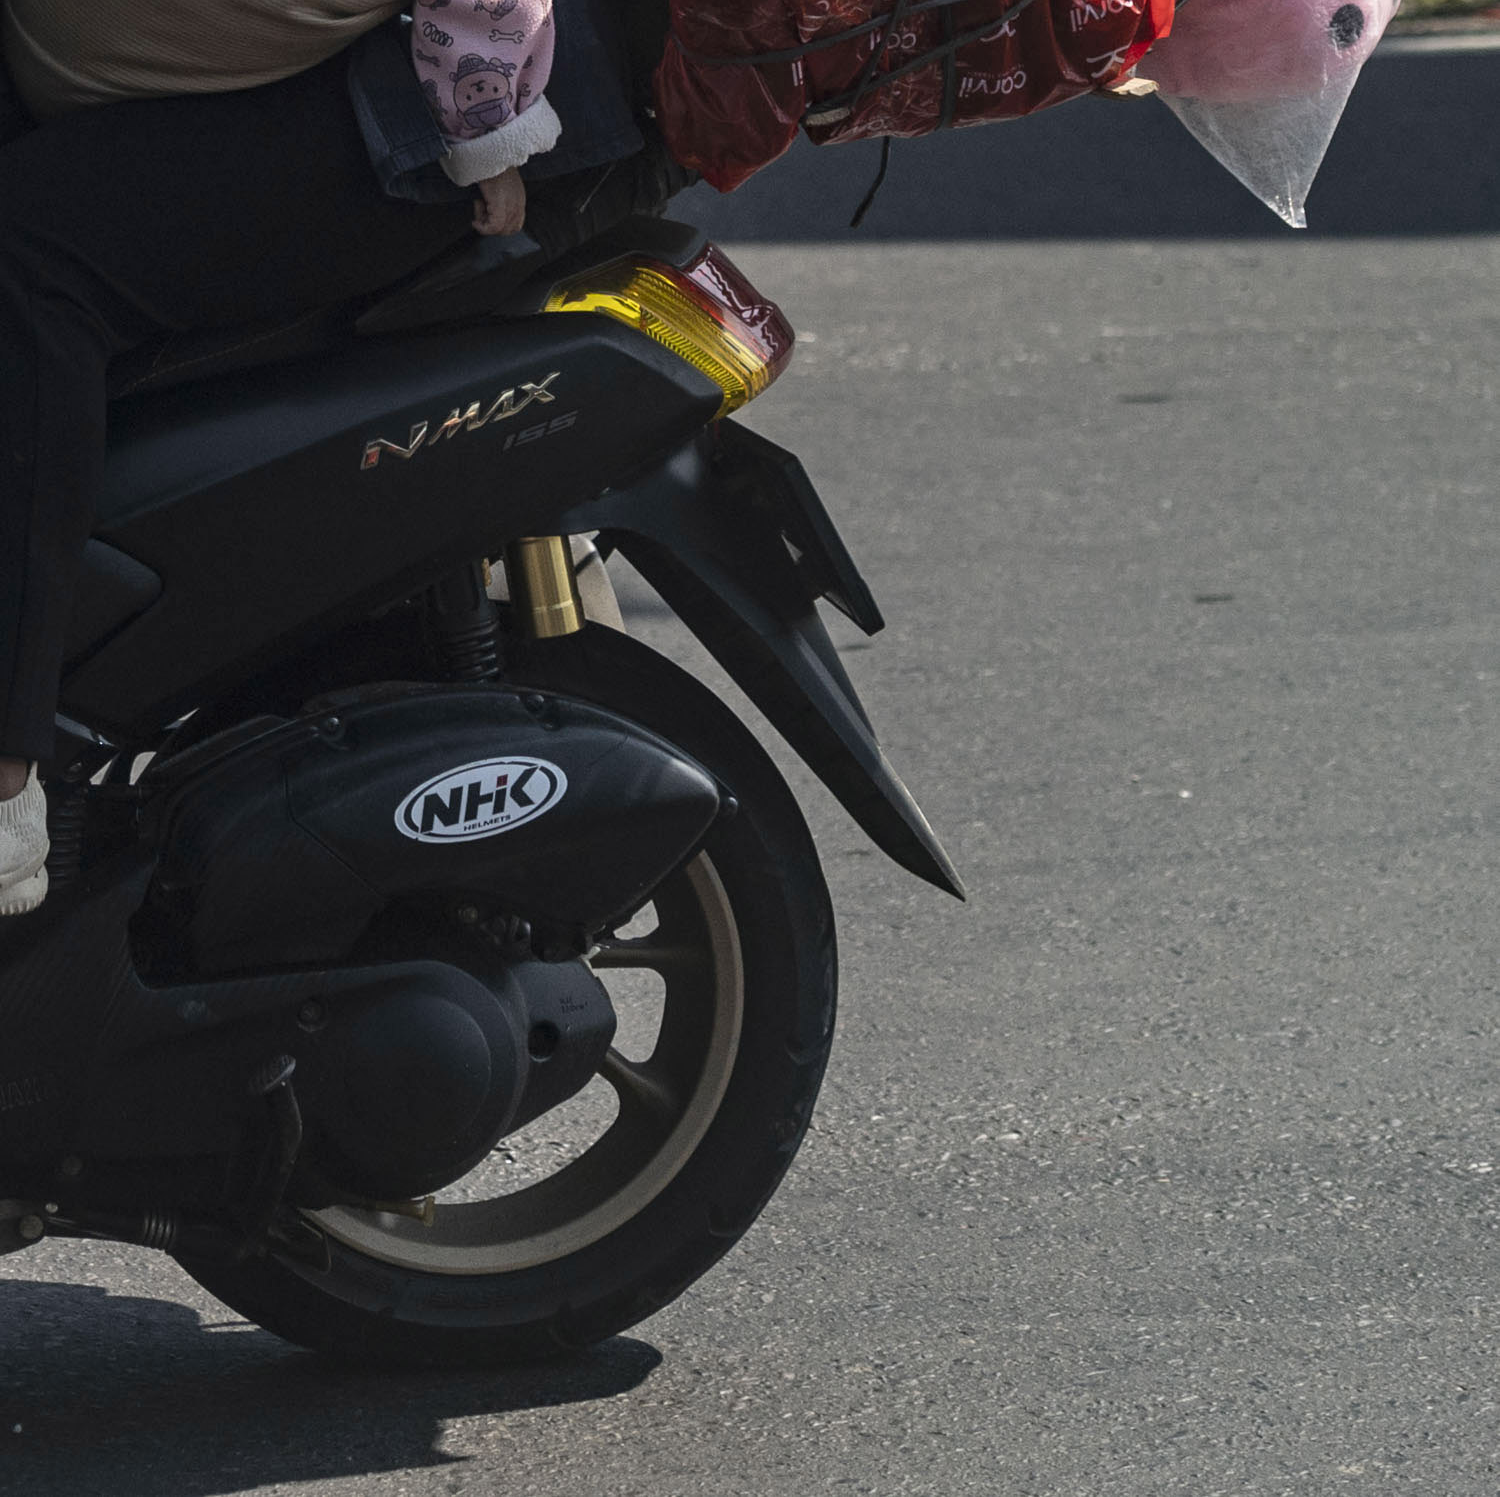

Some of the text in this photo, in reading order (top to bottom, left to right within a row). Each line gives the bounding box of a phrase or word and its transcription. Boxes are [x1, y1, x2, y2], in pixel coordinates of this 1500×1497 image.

[958, 71, 1027, 98] carvil
[420, 765, 540, 834] NHK
[463, 814, 511, 832] HELMETS
